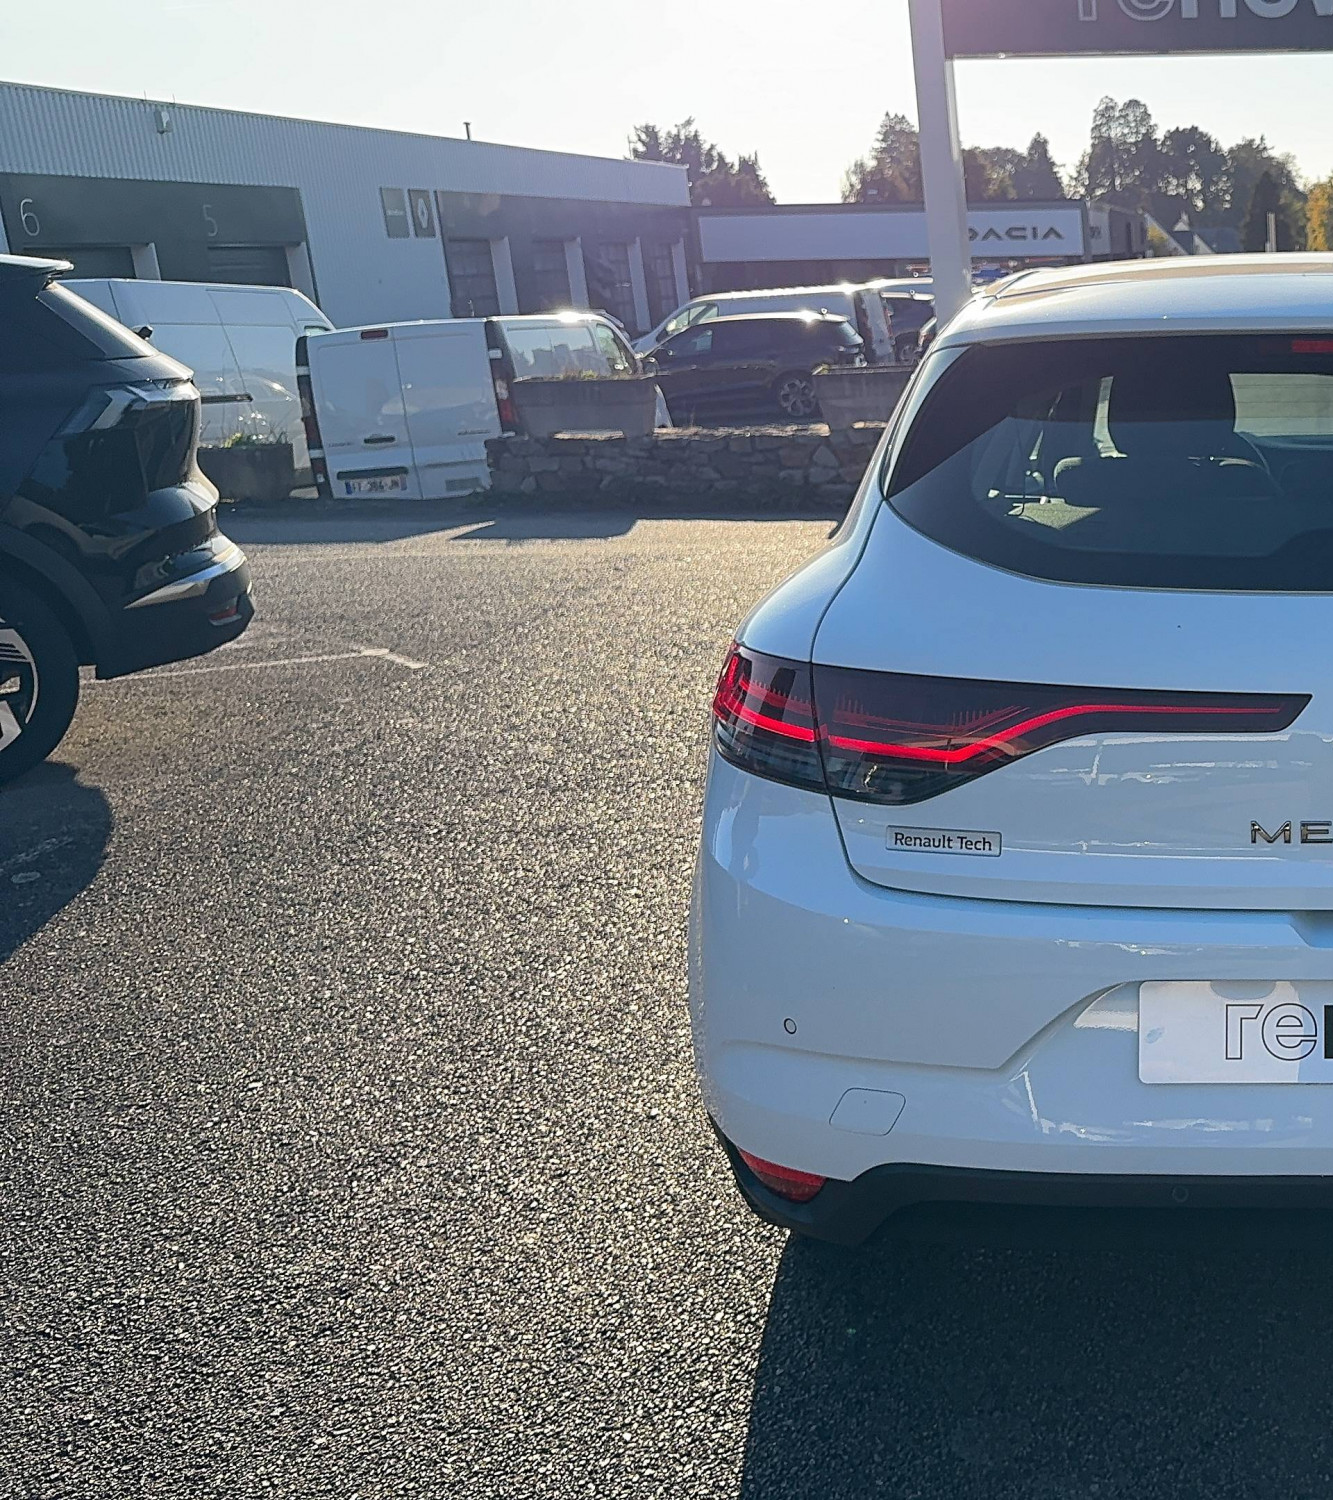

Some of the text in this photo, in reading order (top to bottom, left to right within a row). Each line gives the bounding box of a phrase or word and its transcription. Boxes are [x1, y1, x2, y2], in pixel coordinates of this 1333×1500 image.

[20, 198, 40, 237] 6
[203, 204, 219, 237] 5
[893, 832, 993, 852] Renault Tech
